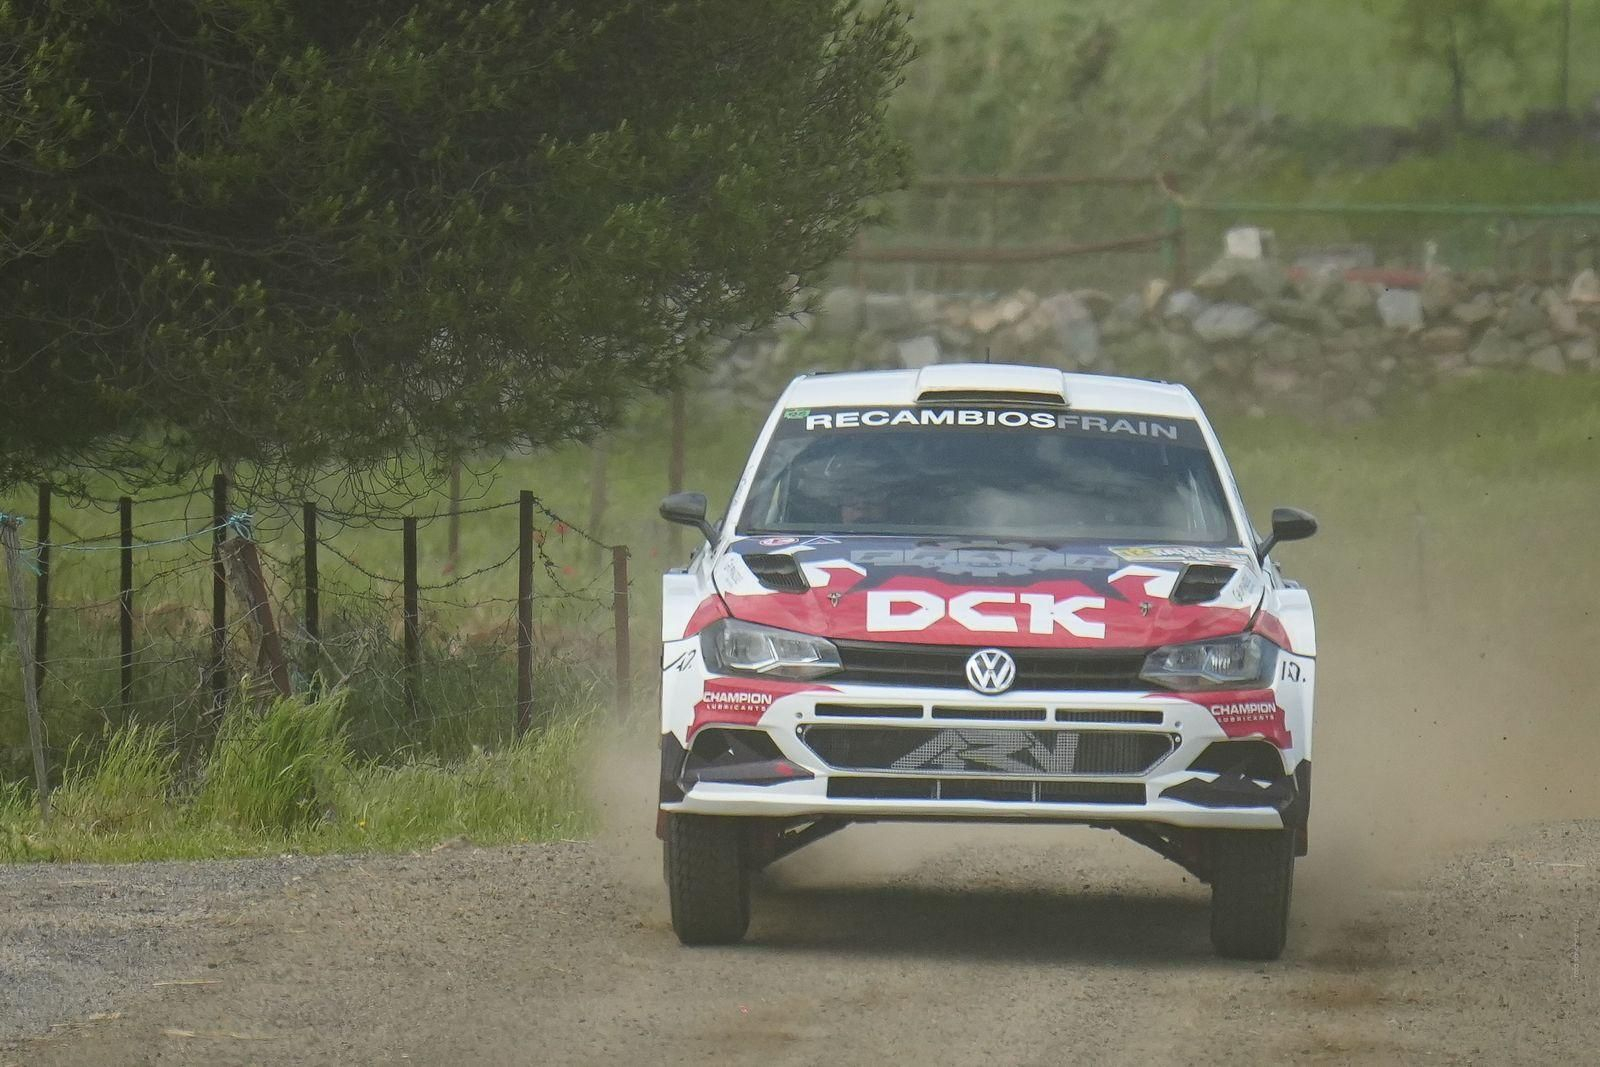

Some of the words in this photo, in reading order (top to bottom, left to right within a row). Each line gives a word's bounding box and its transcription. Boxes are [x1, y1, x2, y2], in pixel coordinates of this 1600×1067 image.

[866, 590, 1106, 639] DCK
[966, 648, 1016, 693] VW
[702, 691, 773, 705] CHAMPION
[706, 703, 767, 712] LUBRICANTS
[1211, 703, 1277, 716] CHAMPION
[1217, 714, 1275, 723] LUBRICANTS
